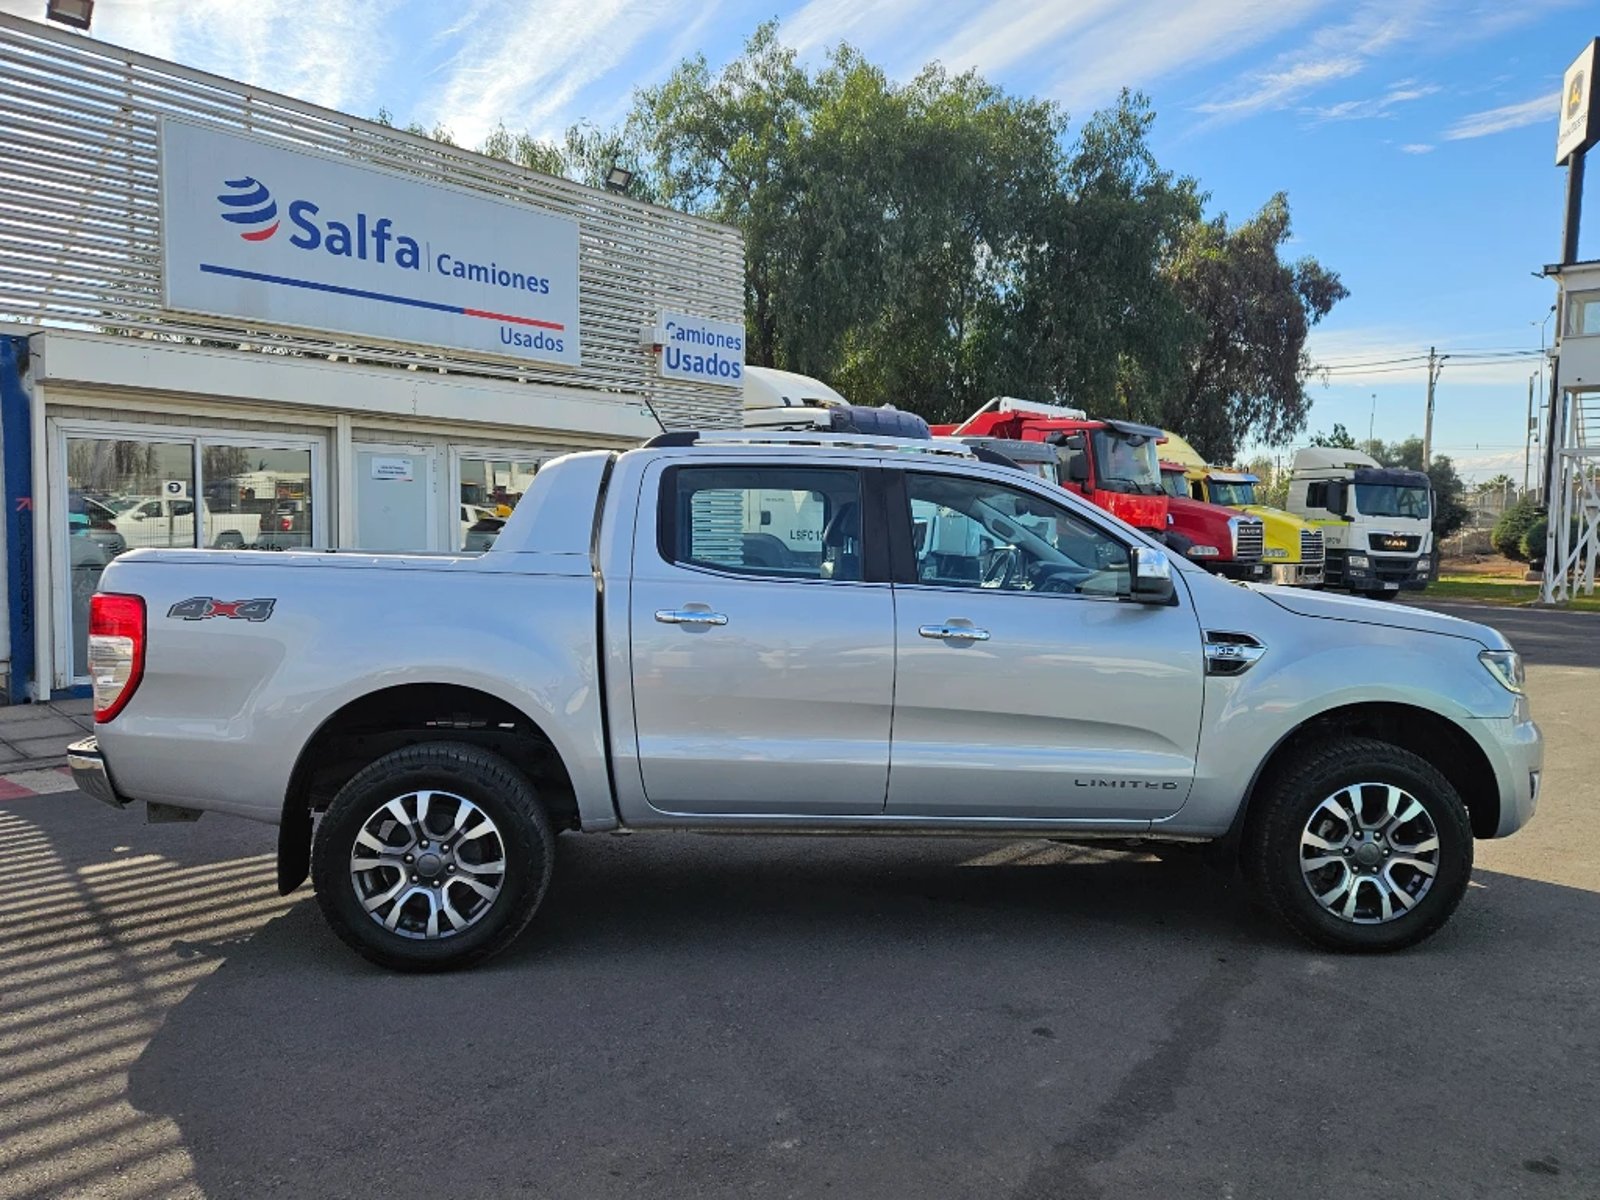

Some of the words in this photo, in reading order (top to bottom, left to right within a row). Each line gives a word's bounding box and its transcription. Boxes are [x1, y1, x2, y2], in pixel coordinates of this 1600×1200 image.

[288, 200, 420, 271] Salfa
[437, 253, 550, 295] Camiones
[500, 326, 564, 353] Usados
[665, 346, 742, 379] Usados
[1074, 778, 1179, 791] LIMITED
